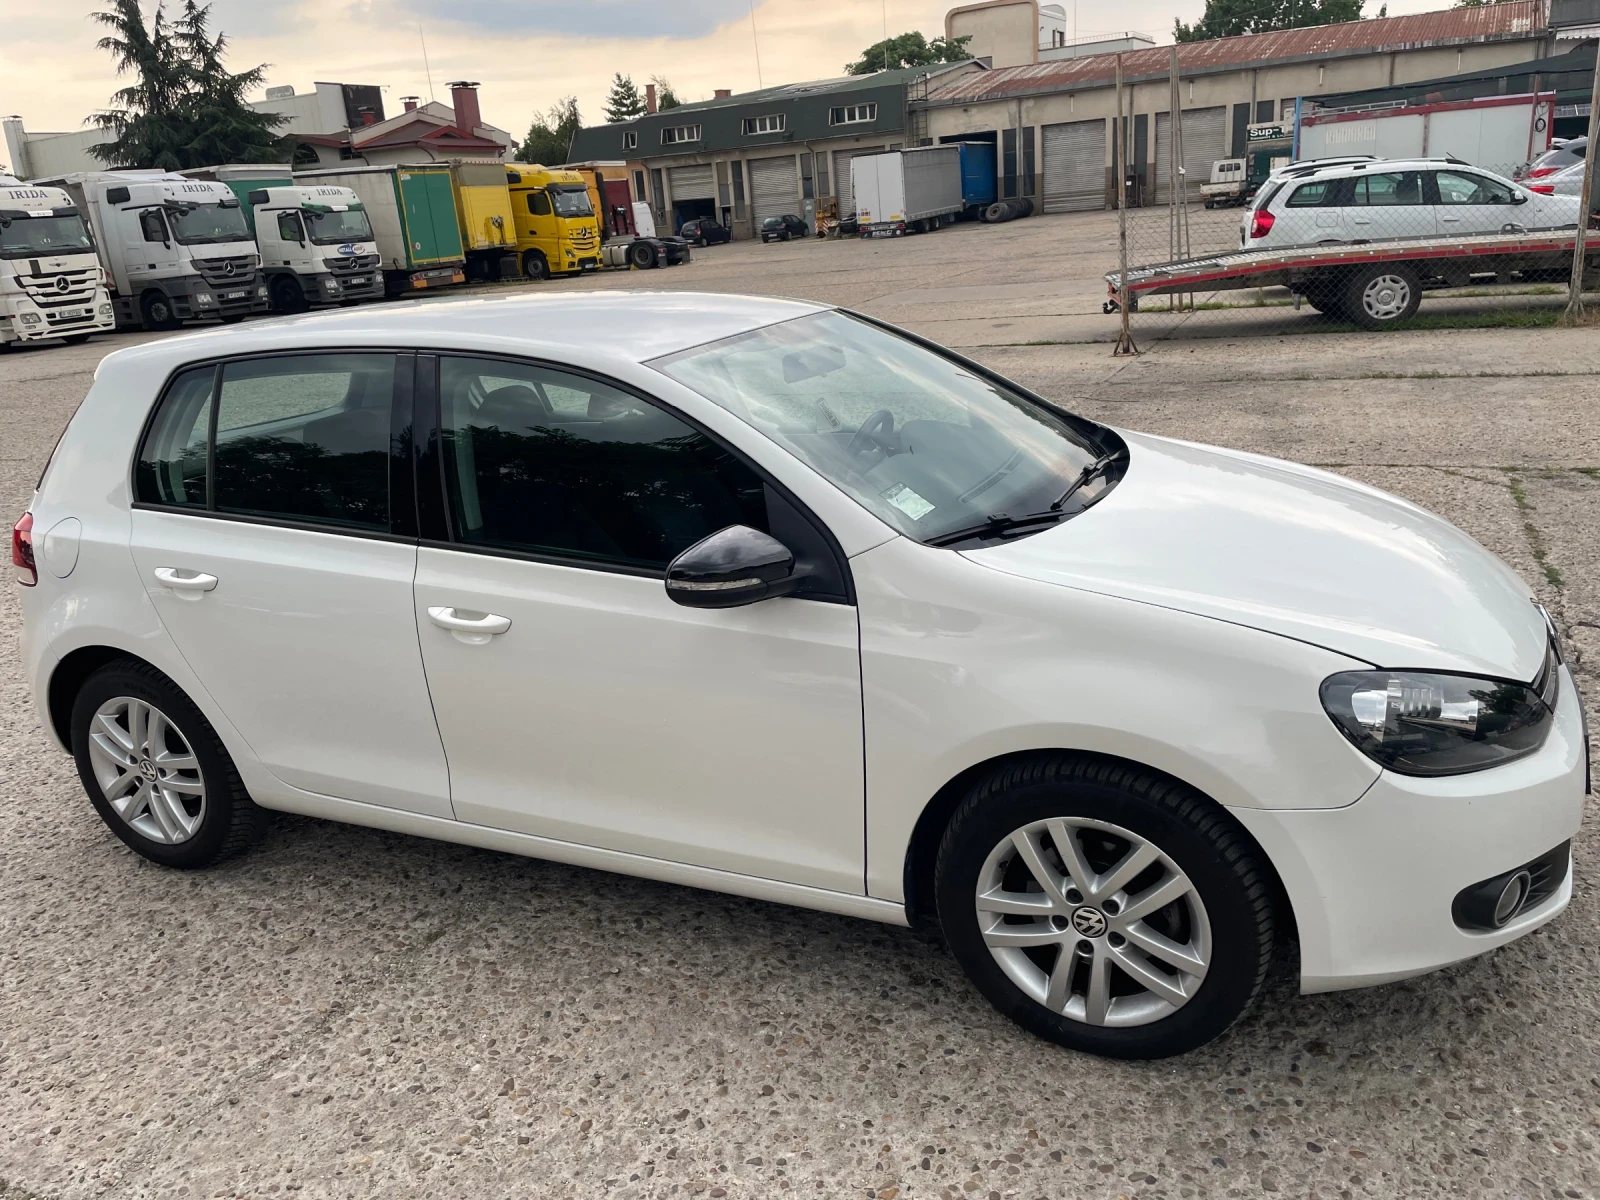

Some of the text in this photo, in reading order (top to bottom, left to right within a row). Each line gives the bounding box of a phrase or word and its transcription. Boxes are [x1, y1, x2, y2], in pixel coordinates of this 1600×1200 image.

[181, 184, 214, 193] IRIDA
[316, 188, 343, 196] IRIDA
[8, 189, 48, 200] IRIDA
